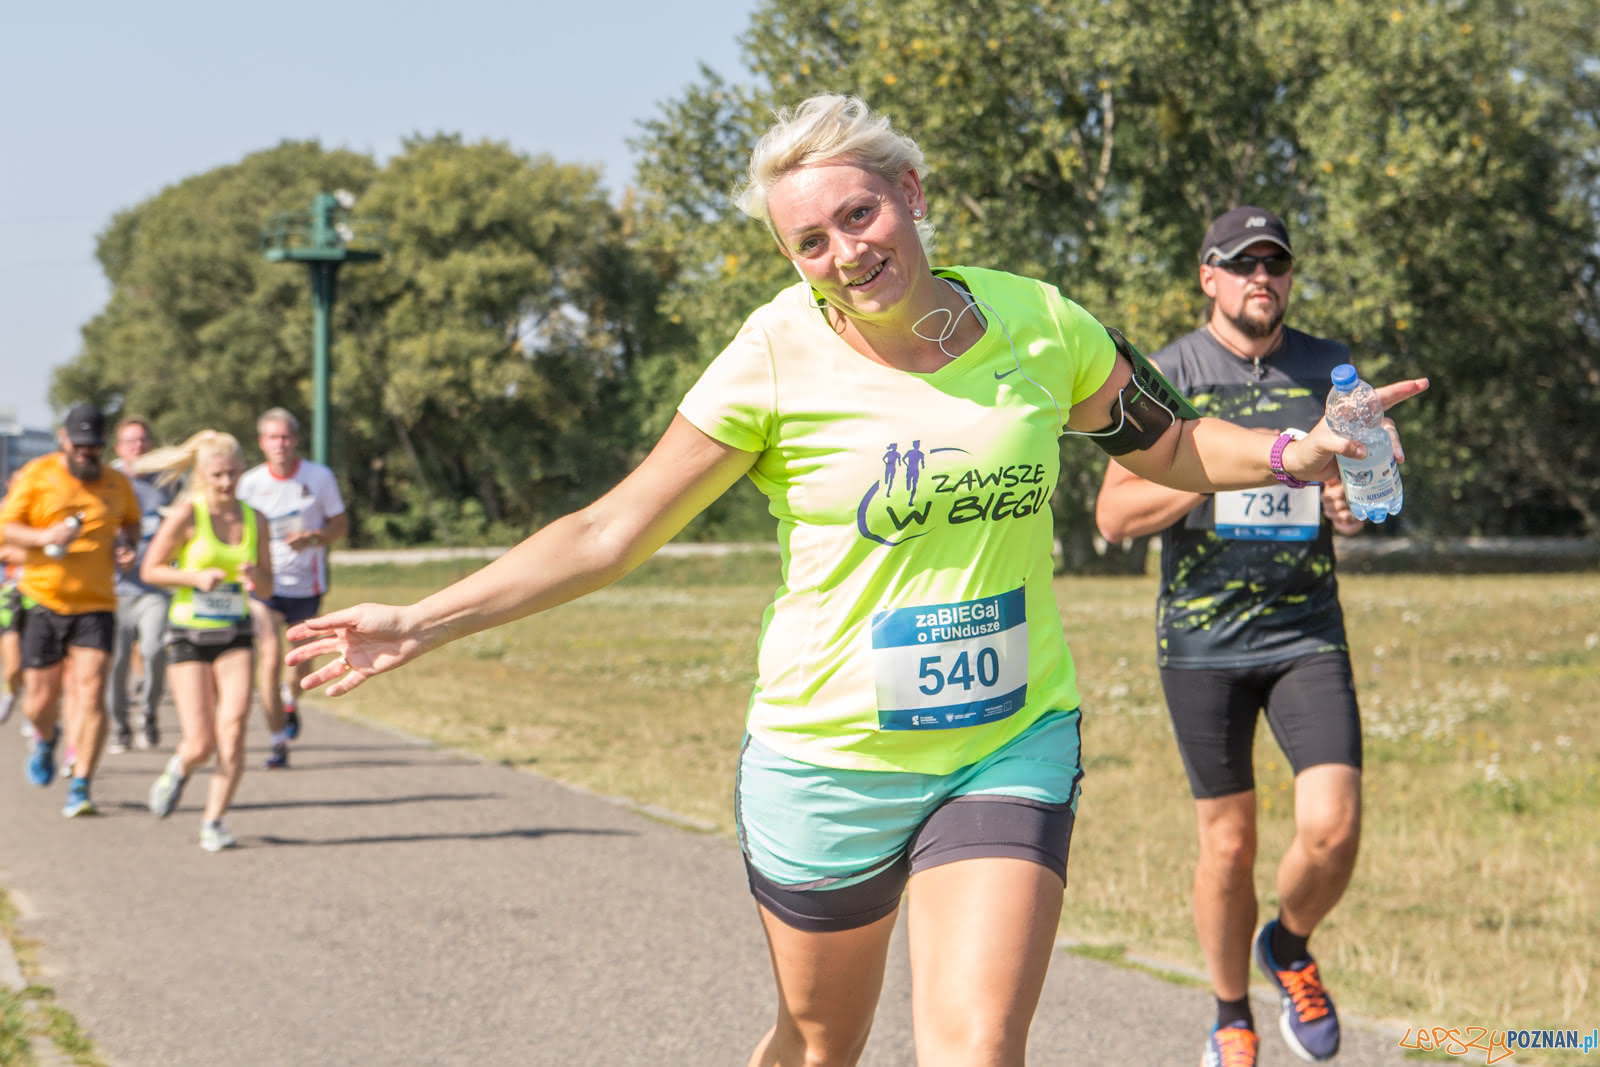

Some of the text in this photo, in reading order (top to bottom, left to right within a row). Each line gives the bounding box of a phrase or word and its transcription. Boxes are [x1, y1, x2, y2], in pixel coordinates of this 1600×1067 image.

[931, 464, 1045, 493] ZAWSZE
[886, 486, 1050, 531] W BIEGU
[1241, 493, 1291, 517] 734
[916, 600, 999, 628] zaBIEGaj
[917, 621, 1000, 643] o FUNdusze
[918, 647, 999, 696] 540
